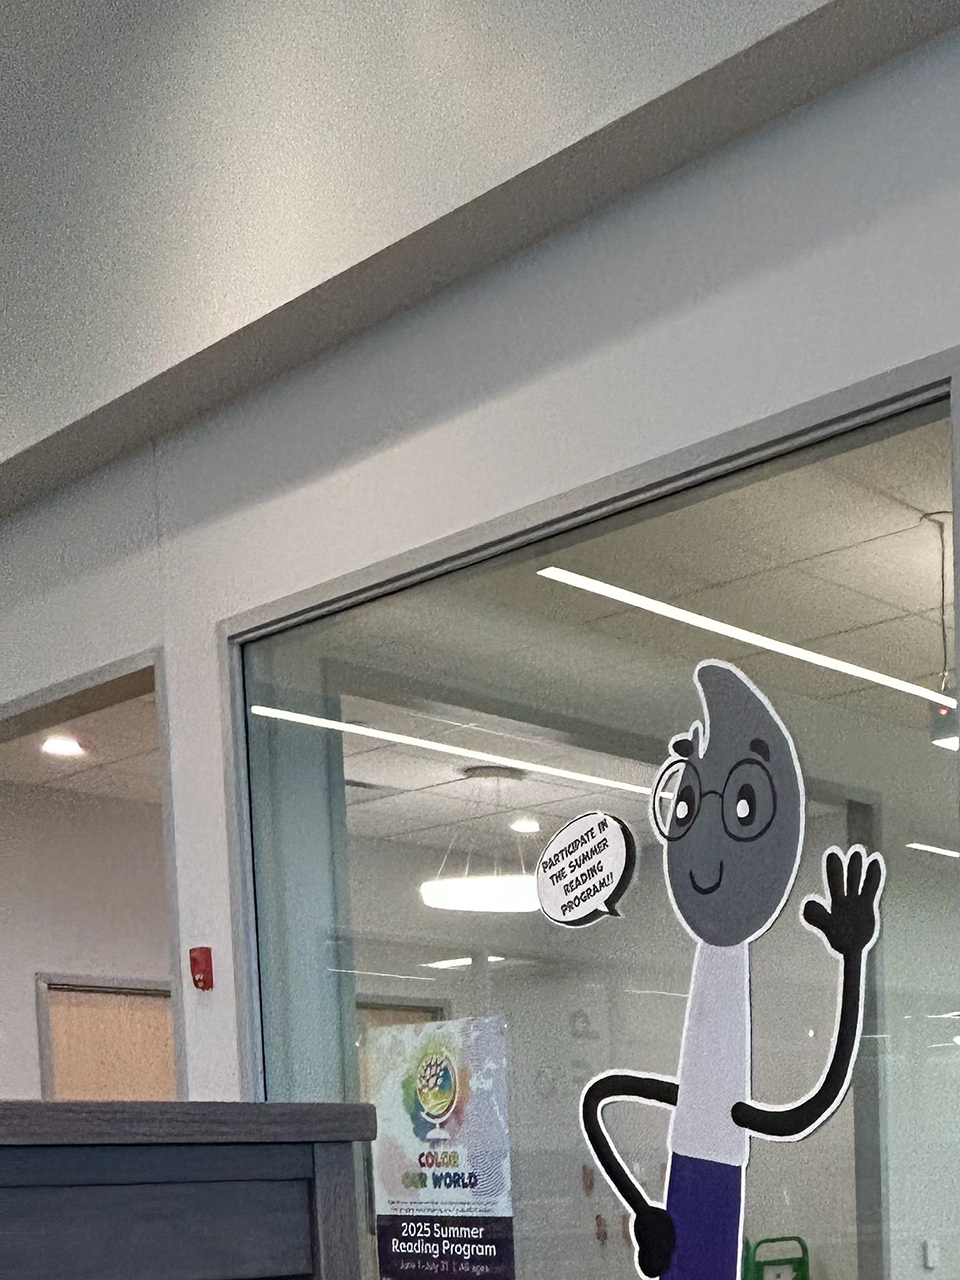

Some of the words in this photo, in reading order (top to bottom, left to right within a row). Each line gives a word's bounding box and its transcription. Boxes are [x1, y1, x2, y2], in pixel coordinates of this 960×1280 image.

[541, 827, 596, 873] PARTICIPATE
[598, 818, 609, 834] IN
[549, 867, 568, 886] THE
[569, 838, 609, 874] SUMMER
[563, 861, 604, 896] READING
[560, 872, 613, 916] PROGRAM!!
[418, 1151, 459, 1168] COLOR
[432, 1171, 478, 1189] WORLD
[401, 1222, 431, 1238] 2025
[433, 1223, 485, 1239] Summer
[391, 1238, 440, 1258] Reading
[442, 1240, 497, 1259] Program
